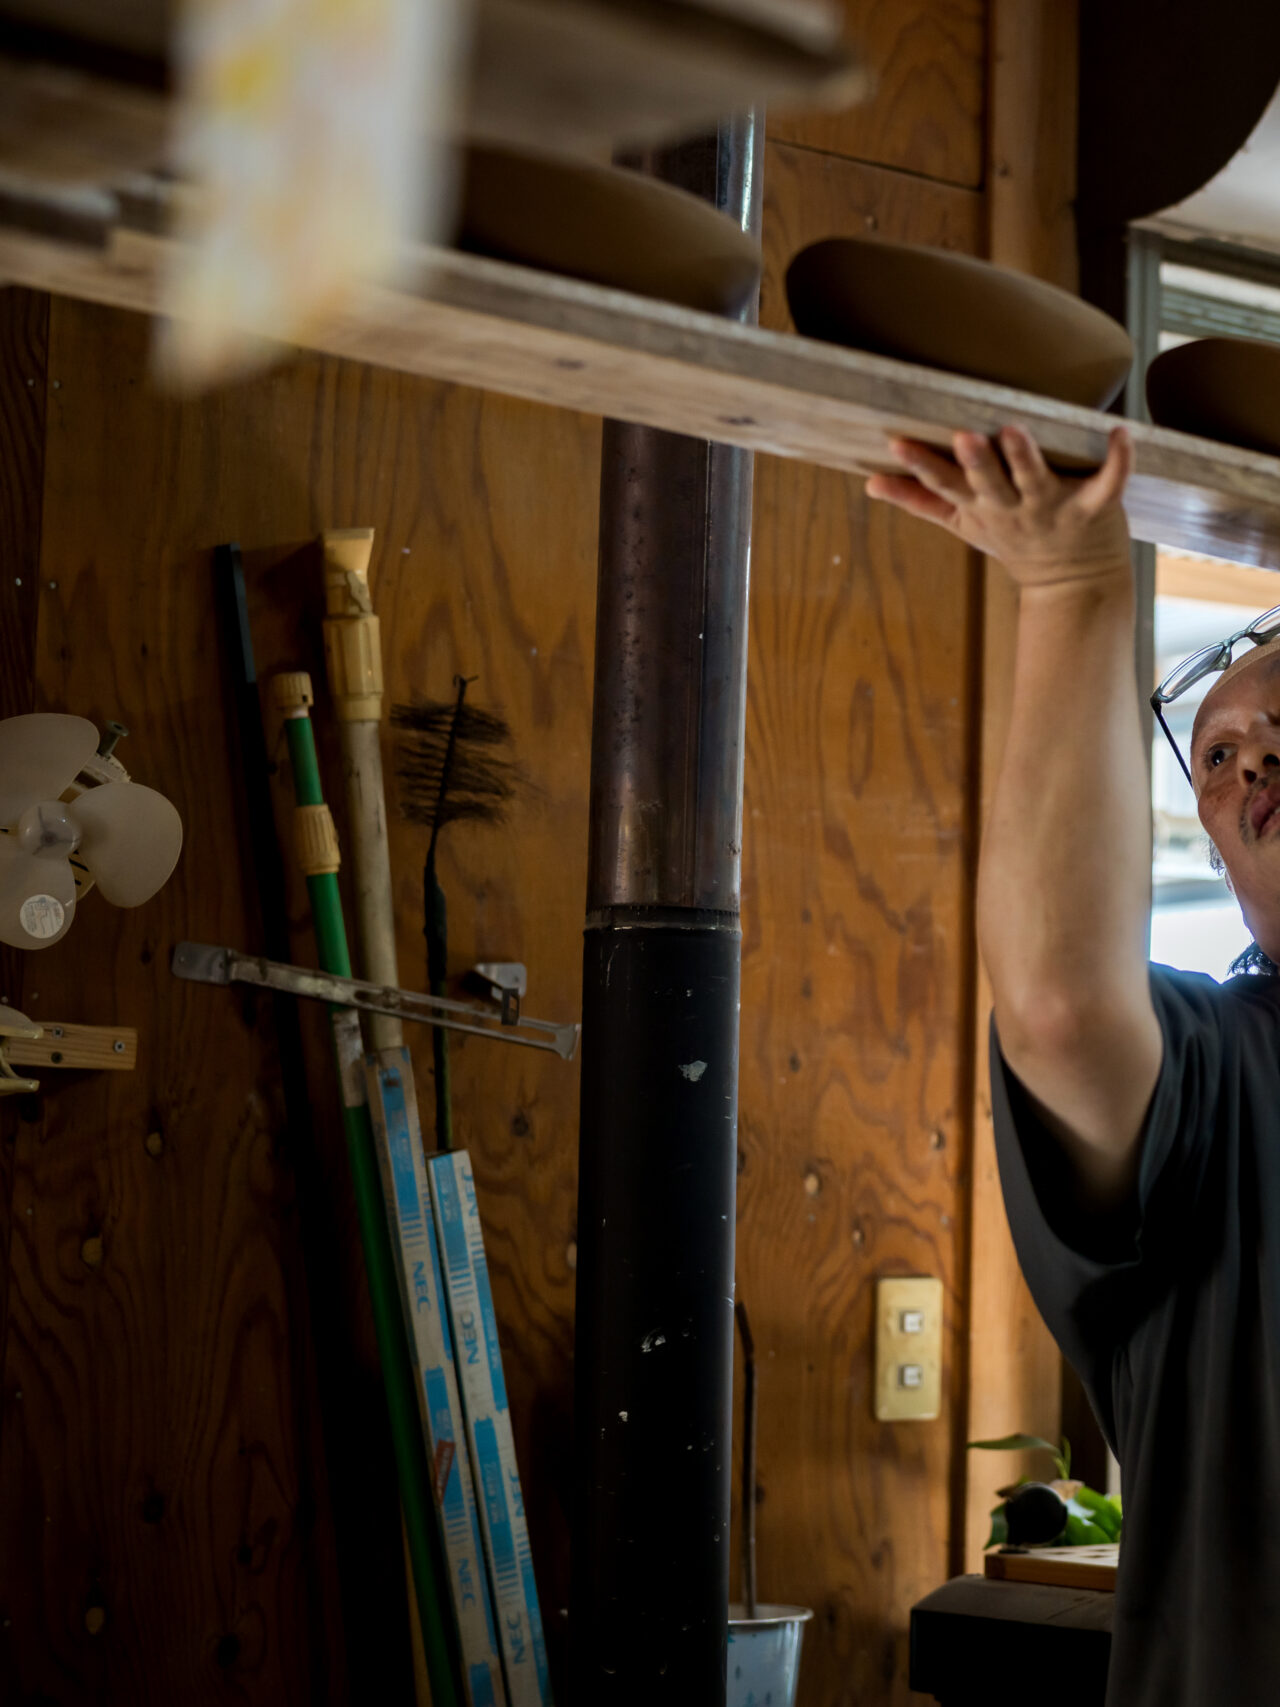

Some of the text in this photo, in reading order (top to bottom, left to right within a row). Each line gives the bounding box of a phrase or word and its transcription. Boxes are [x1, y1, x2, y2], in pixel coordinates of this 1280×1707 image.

[412, 1261, 431, 1313] NEC
[460, 1311, 480, 1364] NEC
[458, 1558, 476, 1610] NEC
[507, 1611, 527, 1664] NEC
